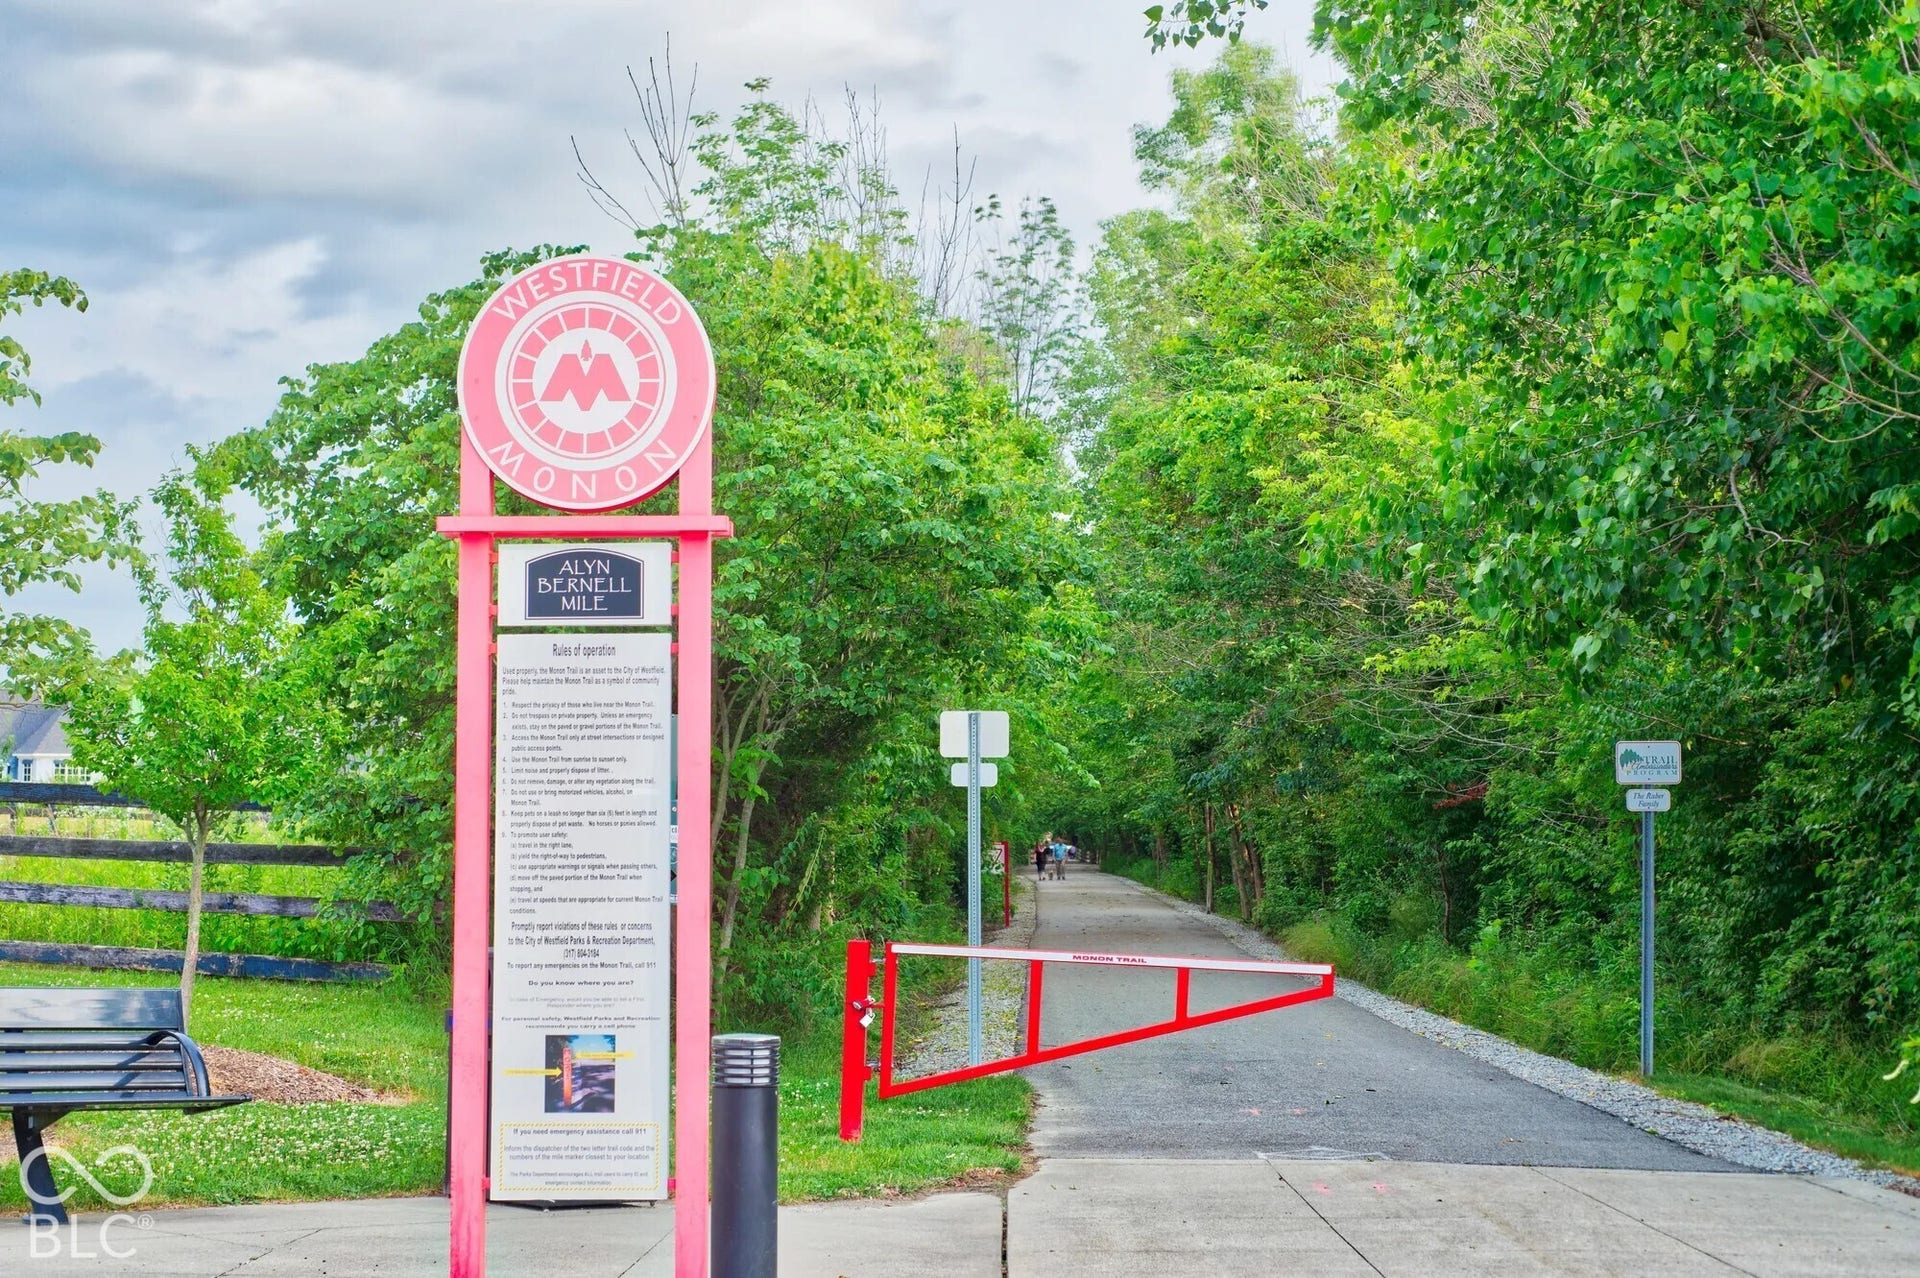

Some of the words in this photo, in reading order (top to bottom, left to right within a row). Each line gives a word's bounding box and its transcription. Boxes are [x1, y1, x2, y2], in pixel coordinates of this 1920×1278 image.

[492, 262, 682, 325] WESTFIELD
[488, 440, 677, 499] MONON
[558, 559, 610, 575] ALYN
[538, 577, 632, 594] BERNELL
[561, 595, 608, 611] MILE
[552, 643, 572, 655] Rules
[574, 643, 580, 655] of
[583, 643, 616, 658] operation
[1644, 756, 1677, 764] TRAIL
[511, 921, 535, 932] Promptly
[536, 921, 553, 932] report
[554, 921, 580, 930] violations
[581, 921, 587, 930] of
[588, 921, 603, 930] these
[604, 921, 618, 930] rules
[508, 936, 514, 945] to
[515, 936, 524, 945] the
[525, 936, 536, 947] City
[537, 936, 543, 945] of
[544, 936, 569, 945] Westfield
[570, 936, 585, 945] Parks
[592, 936, 621, 945] Recreation
[563, 949, 576, 958] (317)
